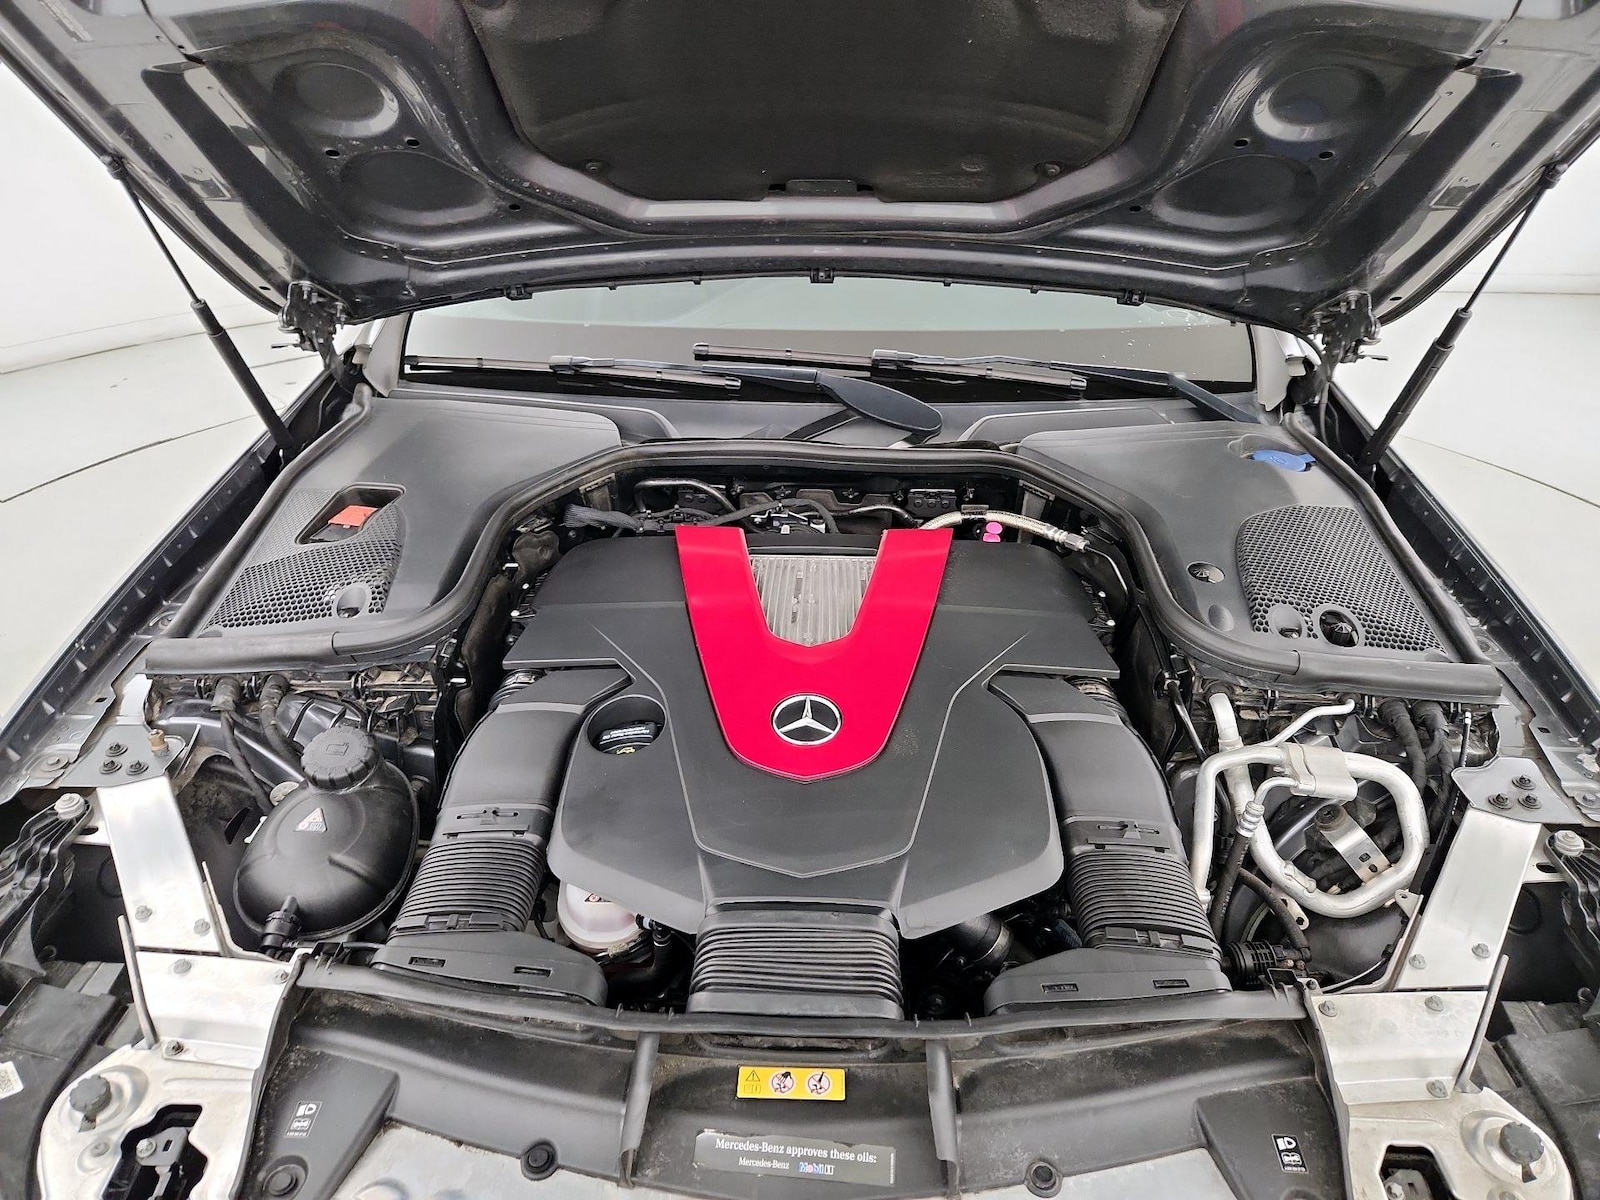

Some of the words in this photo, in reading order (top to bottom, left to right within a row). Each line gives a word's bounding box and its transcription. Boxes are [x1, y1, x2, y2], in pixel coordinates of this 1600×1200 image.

[715, 1137, 785, 1155] Mercedes-Benz
[786, 1145, 828, 1160] approves
[830, 1148, 855, 1161] these
[857, 1151, 878, 1164] oils:
[738, 1157, 790, 1170] Mercedes-Benz
[799, 1161, 825, 1174] Mobil
